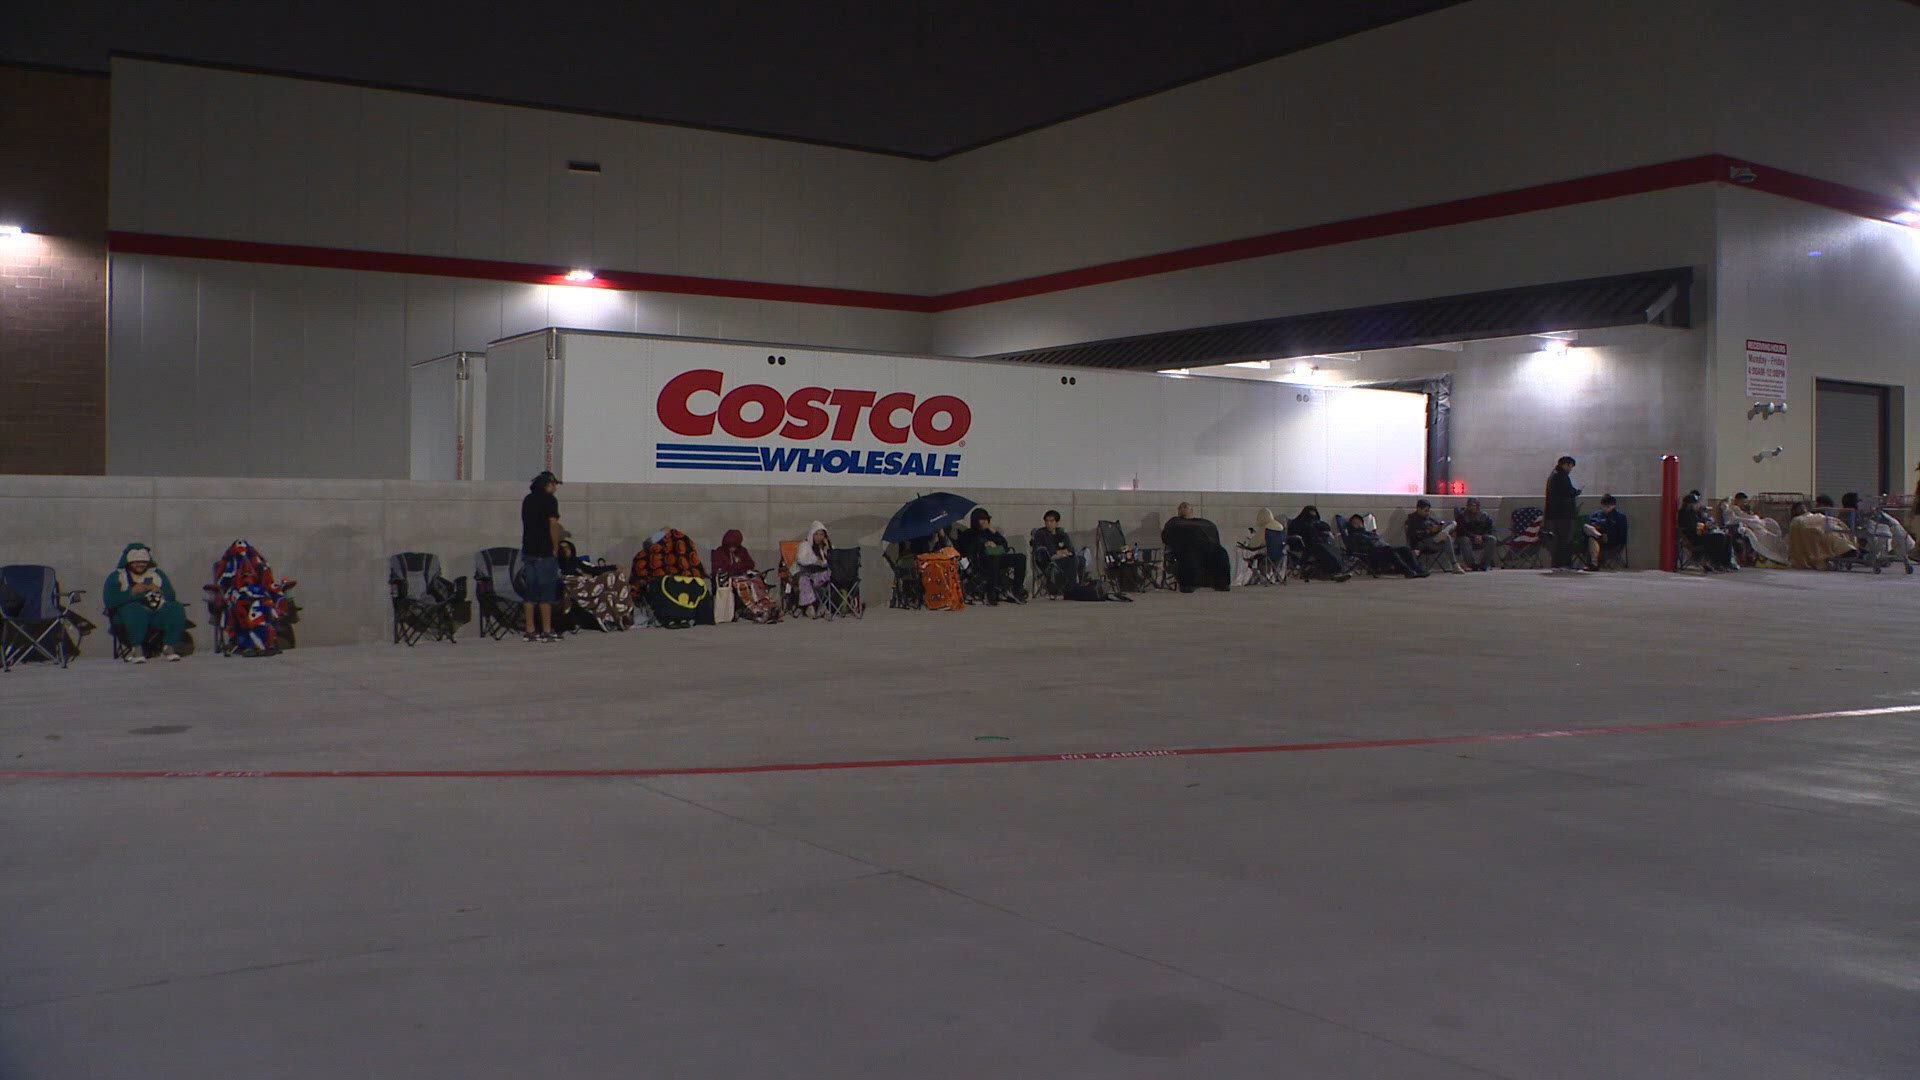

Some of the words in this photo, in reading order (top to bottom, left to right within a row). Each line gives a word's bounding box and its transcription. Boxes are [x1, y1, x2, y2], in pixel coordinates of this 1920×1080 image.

[1748, 354, 1767, 366] Monday
[1771, 356, 1785, 368] Friday
[656, 369, 972, 446] COSTCO
[760, 446, 962, 477] WHOLESALE
[1095, 750, 1177, 759] PARKING
